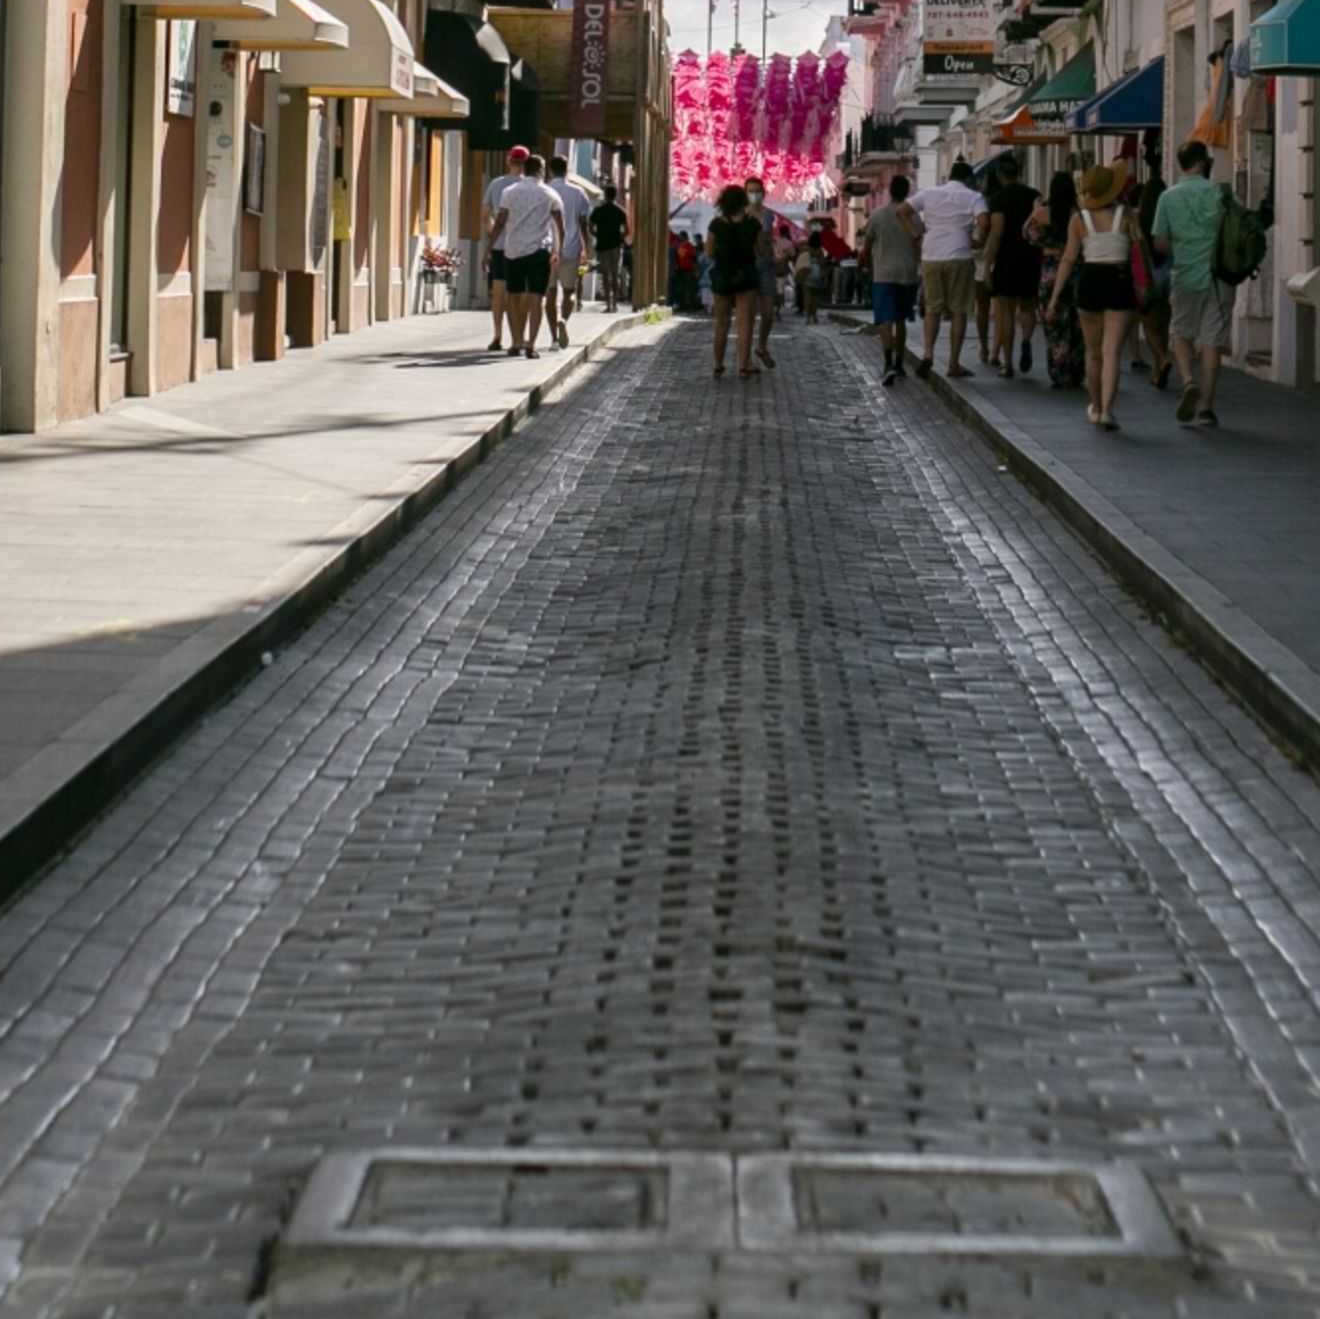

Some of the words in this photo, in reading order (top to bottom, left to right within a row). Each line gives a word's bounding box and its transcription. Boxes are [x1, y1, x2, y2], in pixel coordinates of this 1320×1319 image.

[584, 3, 604, 40] DEL
[944, 55, 975, 72] Open
[581, 68, 601, 109] SOL
